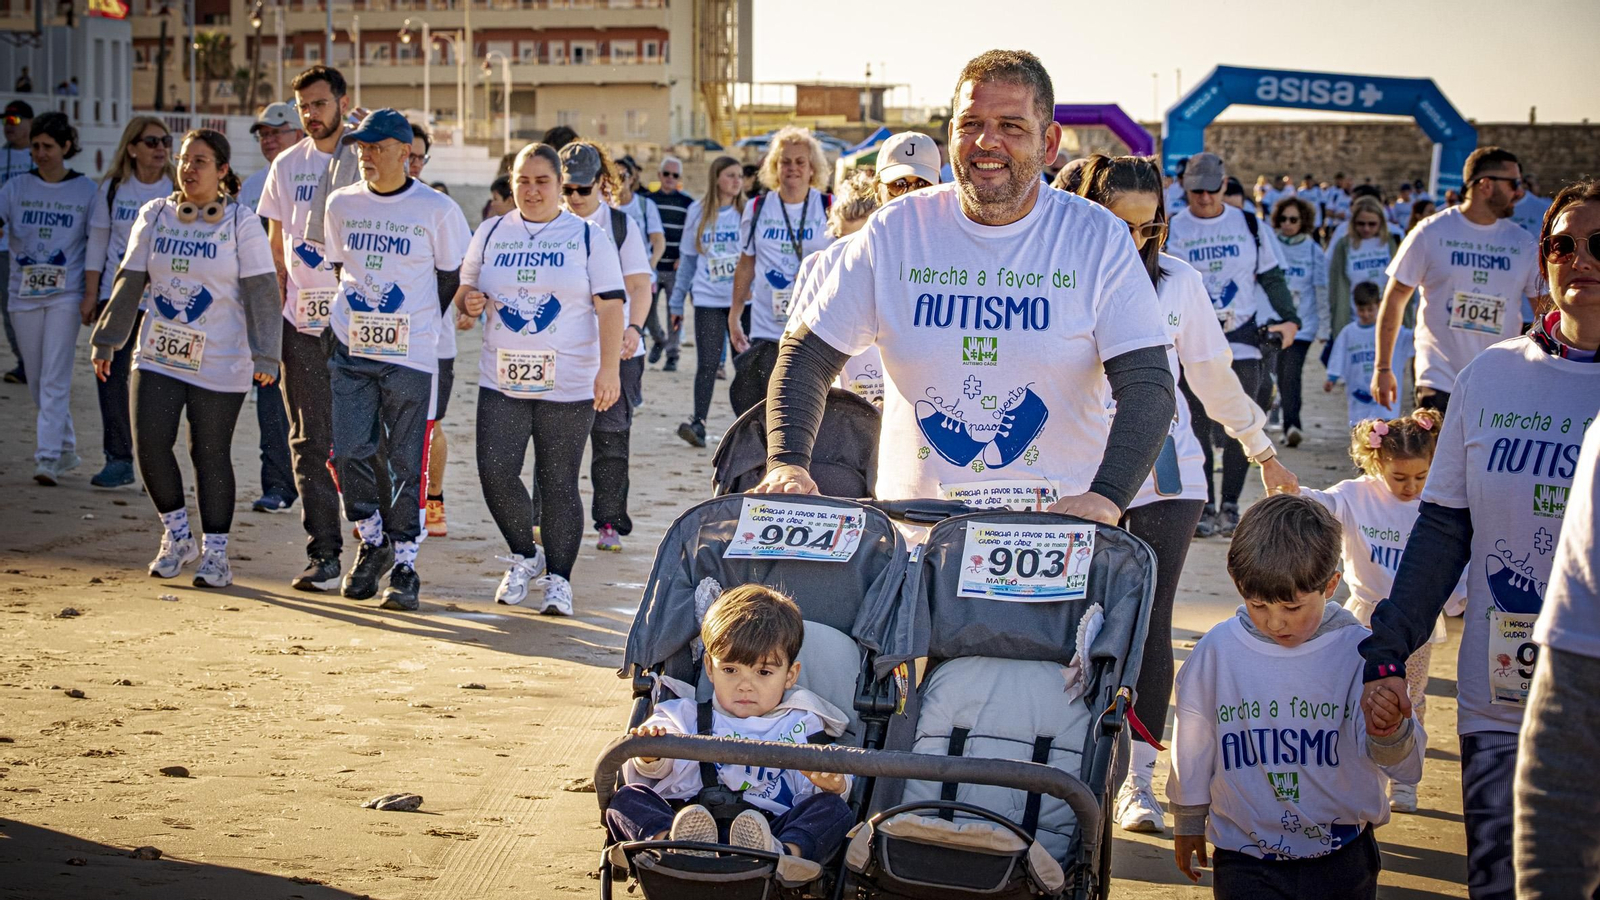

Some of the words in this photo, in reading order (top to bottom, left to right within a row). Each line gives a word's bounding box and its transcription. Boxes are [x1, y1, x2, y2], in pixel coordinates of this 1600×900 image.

[1257, 76, 1354, 106] asisa
[905, 144, 915, 156] J
[294, 172, 318, 182] march
[22, 210, 73, 228] AUTISMO
[346, 220, 372, 230] marcha
[376, 222, 382, 230] a
[385, 220, 409, 234] favor
[413, 223, 425, 236] del
[153, 237, 216, 259] AUTISMO
[347, 232, 410, 256] AUTISMO
[494, 241, 523, 250] marcha
[538, 240, 562, 249] favor
[566, 240, 580, 250] del
[1189, 244, 1240, 262] AUTISMO
[493, 252, 565, 268] AUTISMO
[712, 262, 737, 275] 110
[1451, 251, 1511, 271] AUTISMO
[30, 274, 56, 288] 945
[909, 266, 968, 286] marcha
[977, 272, 986, 286] a
[997, 268, 1044, 289] favor
[1052, 268, 1076, 289] del
[308, 301, 332, 317] 36
[914, 293, 1050, 331] AUTISMO
[1168, 311, 1181, 327] del
[1459, 304, 1498, 323] 1041
[360, 326, 396, 344] 380
[156, 336, 190, 358] 364
[508, 363, 543, 381] 823
[926, 387, 967, 423] Cada
[992, 381, 1035, 420] cuenta
[1479, 408, 1483, 427] I
[1490, 412, 1551, 432] marcha
[1560, 418, 1571, 433] a
[1487, 438, 1581, 479] AUTIS
[758, 525, 834, 550] 904
[989, 547, 1066, 578] 903
[1495, 538, 1537, 581] Cada
[1269, 700, 1279, 717] a
[1290, 696, 1339, 720] favor
[1222, 728, 1340, 771] AUTISMO
